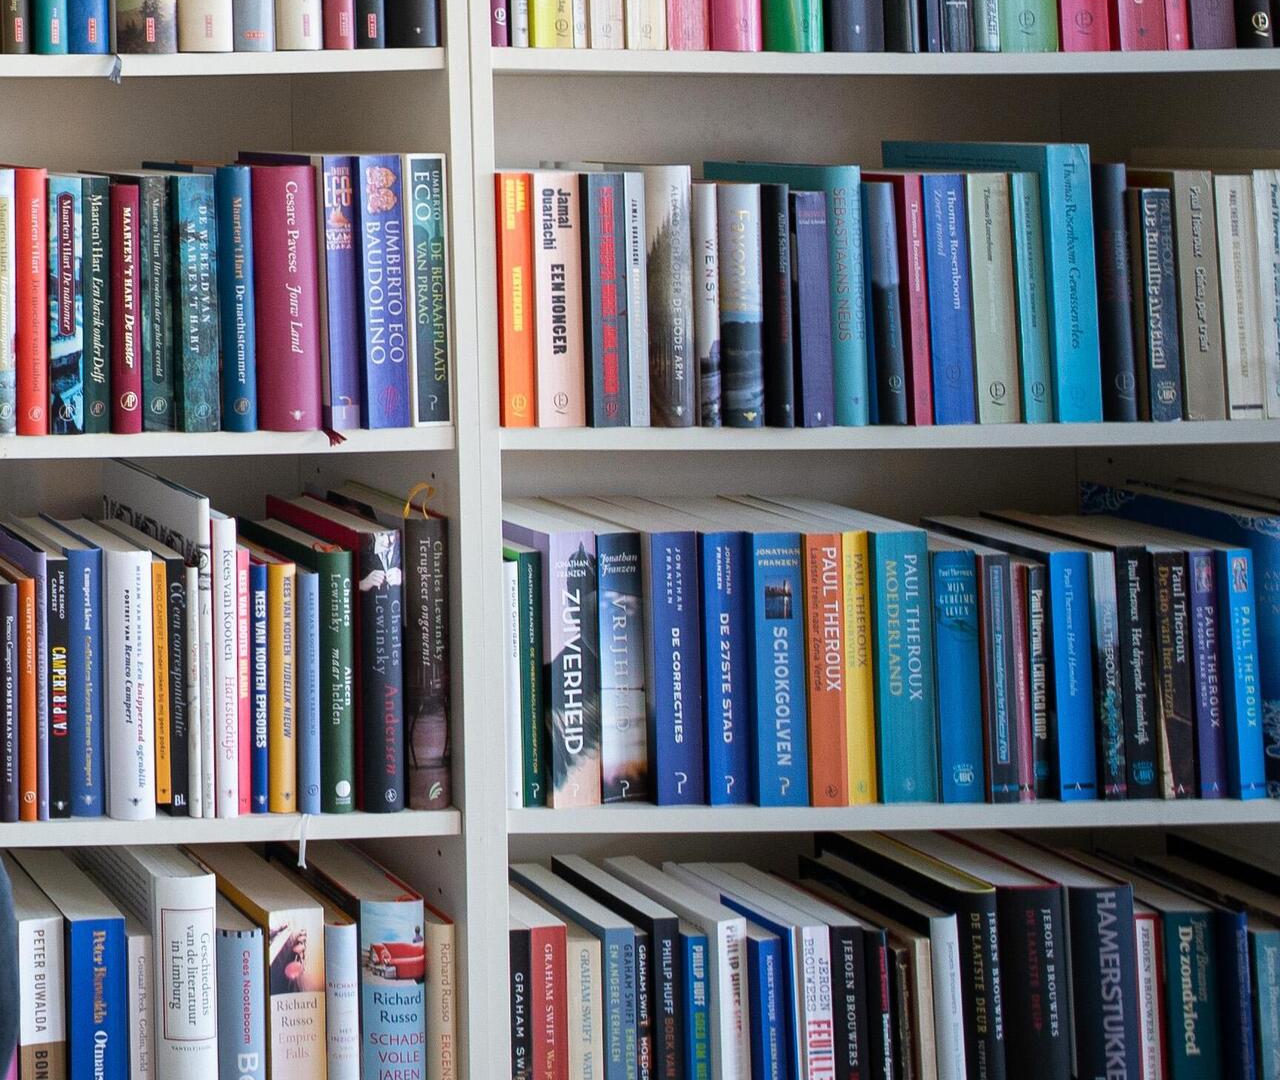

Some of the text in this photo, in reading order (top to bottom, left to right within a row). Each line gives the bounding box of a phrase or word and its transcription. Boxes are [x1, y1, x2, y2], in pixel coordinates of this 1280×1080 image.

[413, 170, 431, 220] ECO
[365, 220, 386, 364] BAUDOLINO
[385, 220, 406, 363] UMBERTO ECO
[550, 264, 566, 355] EEN HONGER
[560, 589, 583, 754] ZUIVERHEID
[719, 612, 734, 743] DE 27STE STAD
[823, 547, 841, 691] PAUL THEROUX
[773, 627, 793, 765] SCHOKGOLVEN
[32, 930, 47, 1032] PETER BUWALDA
[662, 939, 673, 1014] PHILIP HUFF
